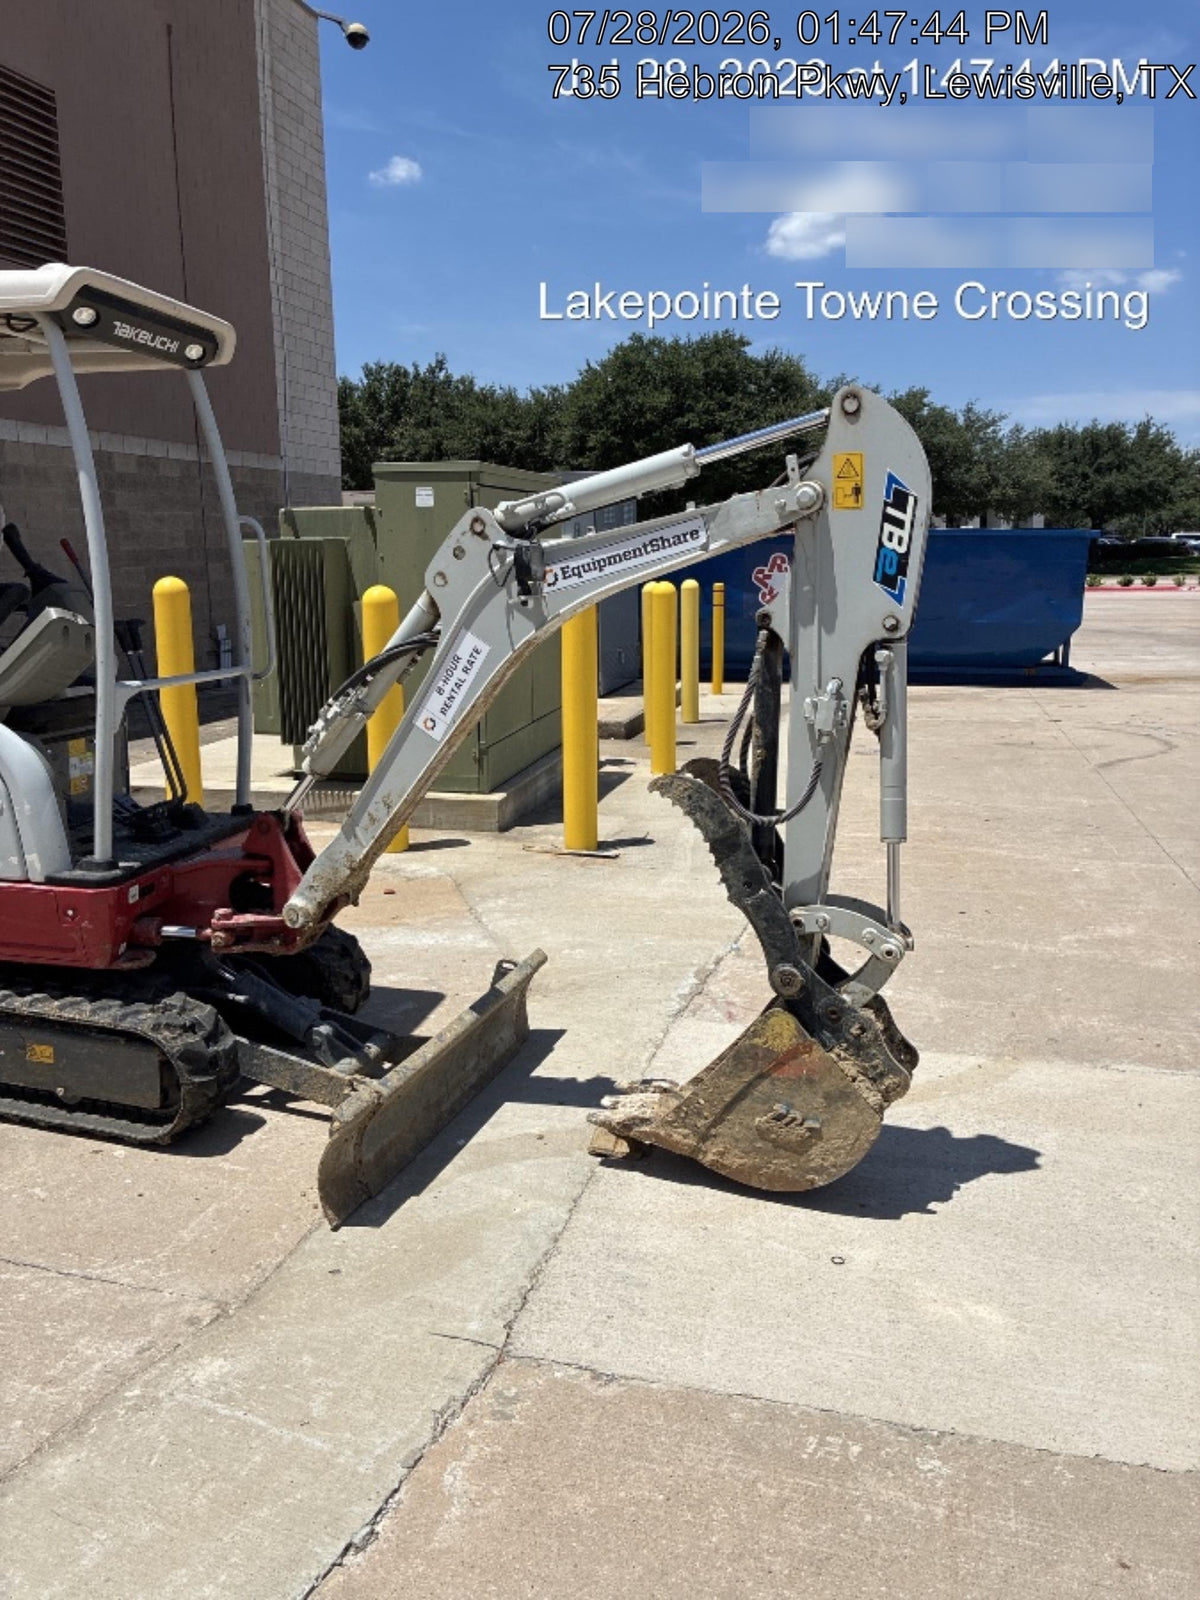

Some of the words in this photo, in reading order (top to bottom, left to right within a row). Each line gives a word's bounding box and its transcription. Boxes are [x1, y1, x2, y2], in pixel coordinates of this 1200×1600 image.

[559, 527, 700, 579] EquipmentShare
[436, 654, 462, 695] 8-HOUR
[440, 677, 466, 716] RENTAL
[462, 646, 482, 674] RATE
